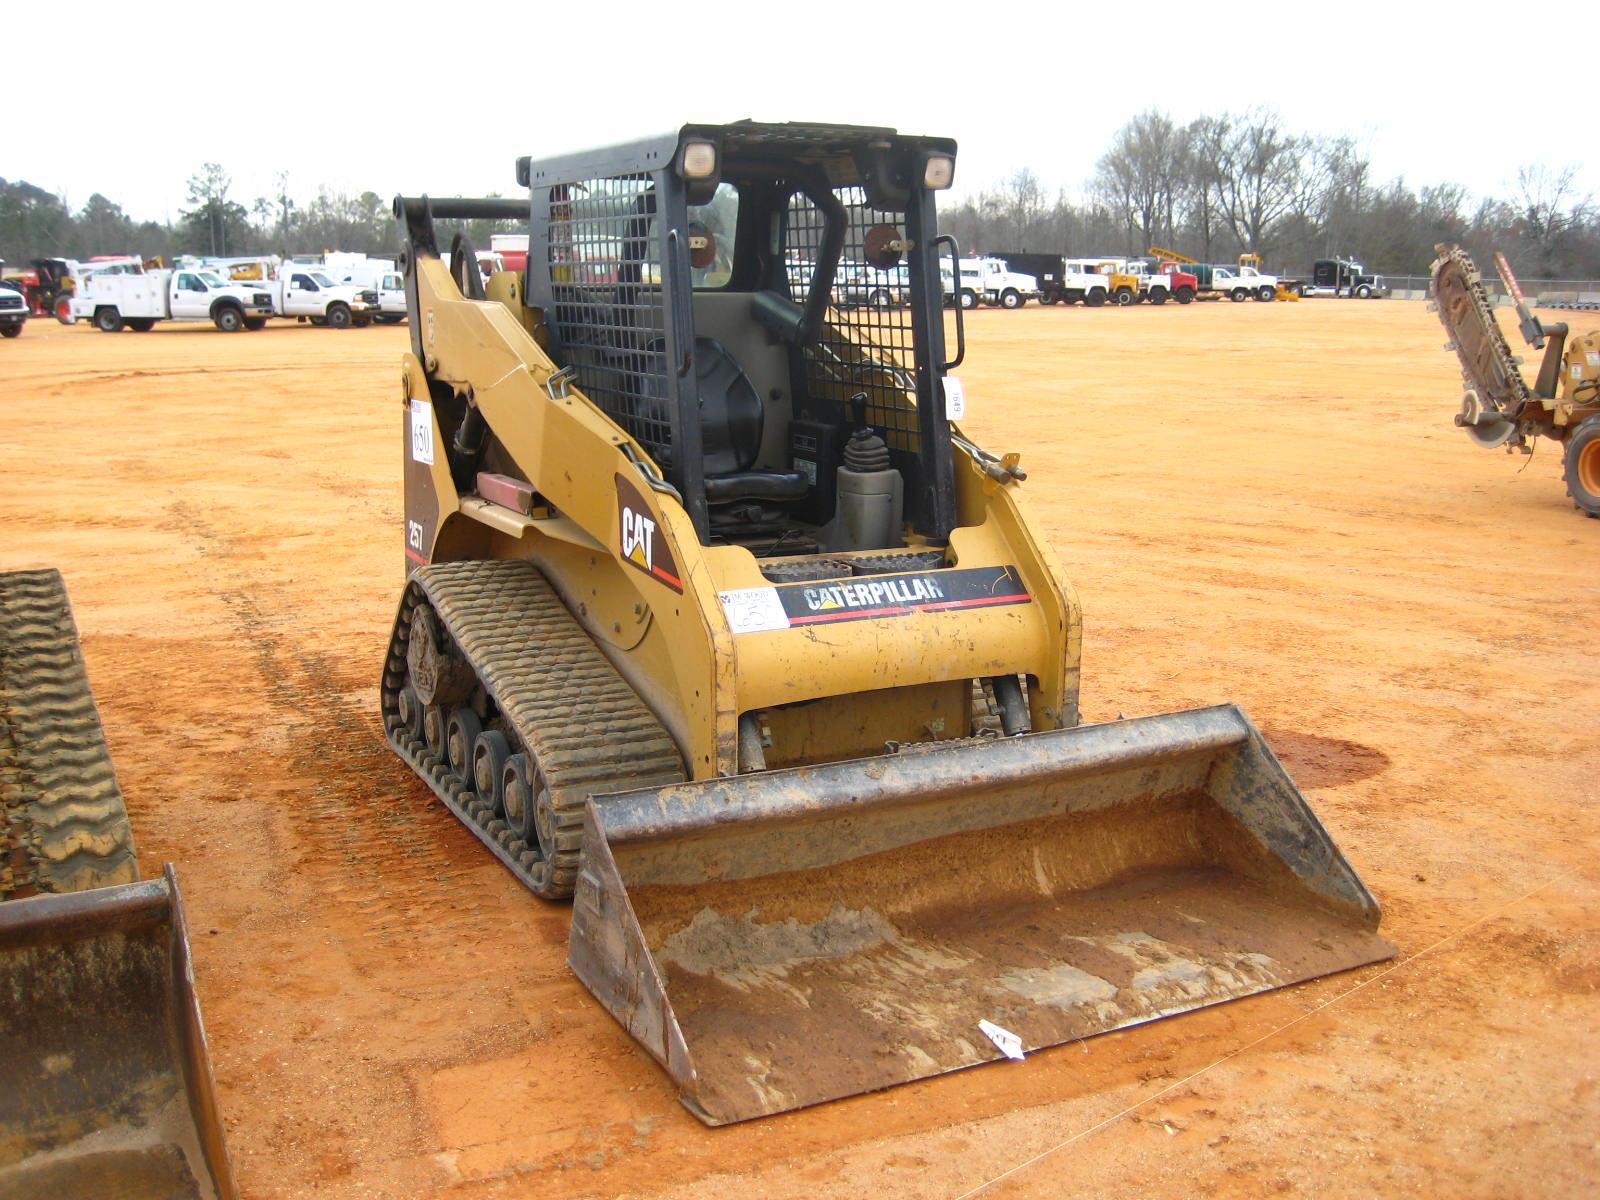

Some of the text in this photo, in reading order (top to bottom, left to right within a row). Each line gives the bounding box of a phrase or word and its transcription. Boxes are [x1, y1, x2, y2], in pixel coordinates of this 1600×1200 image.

[414, 423, 430, 454] 650
[409, 519, 423, 551] 257
[622, 506, 656, 571] CAT
[803, 578, 945, 611] CATERPILLAR
